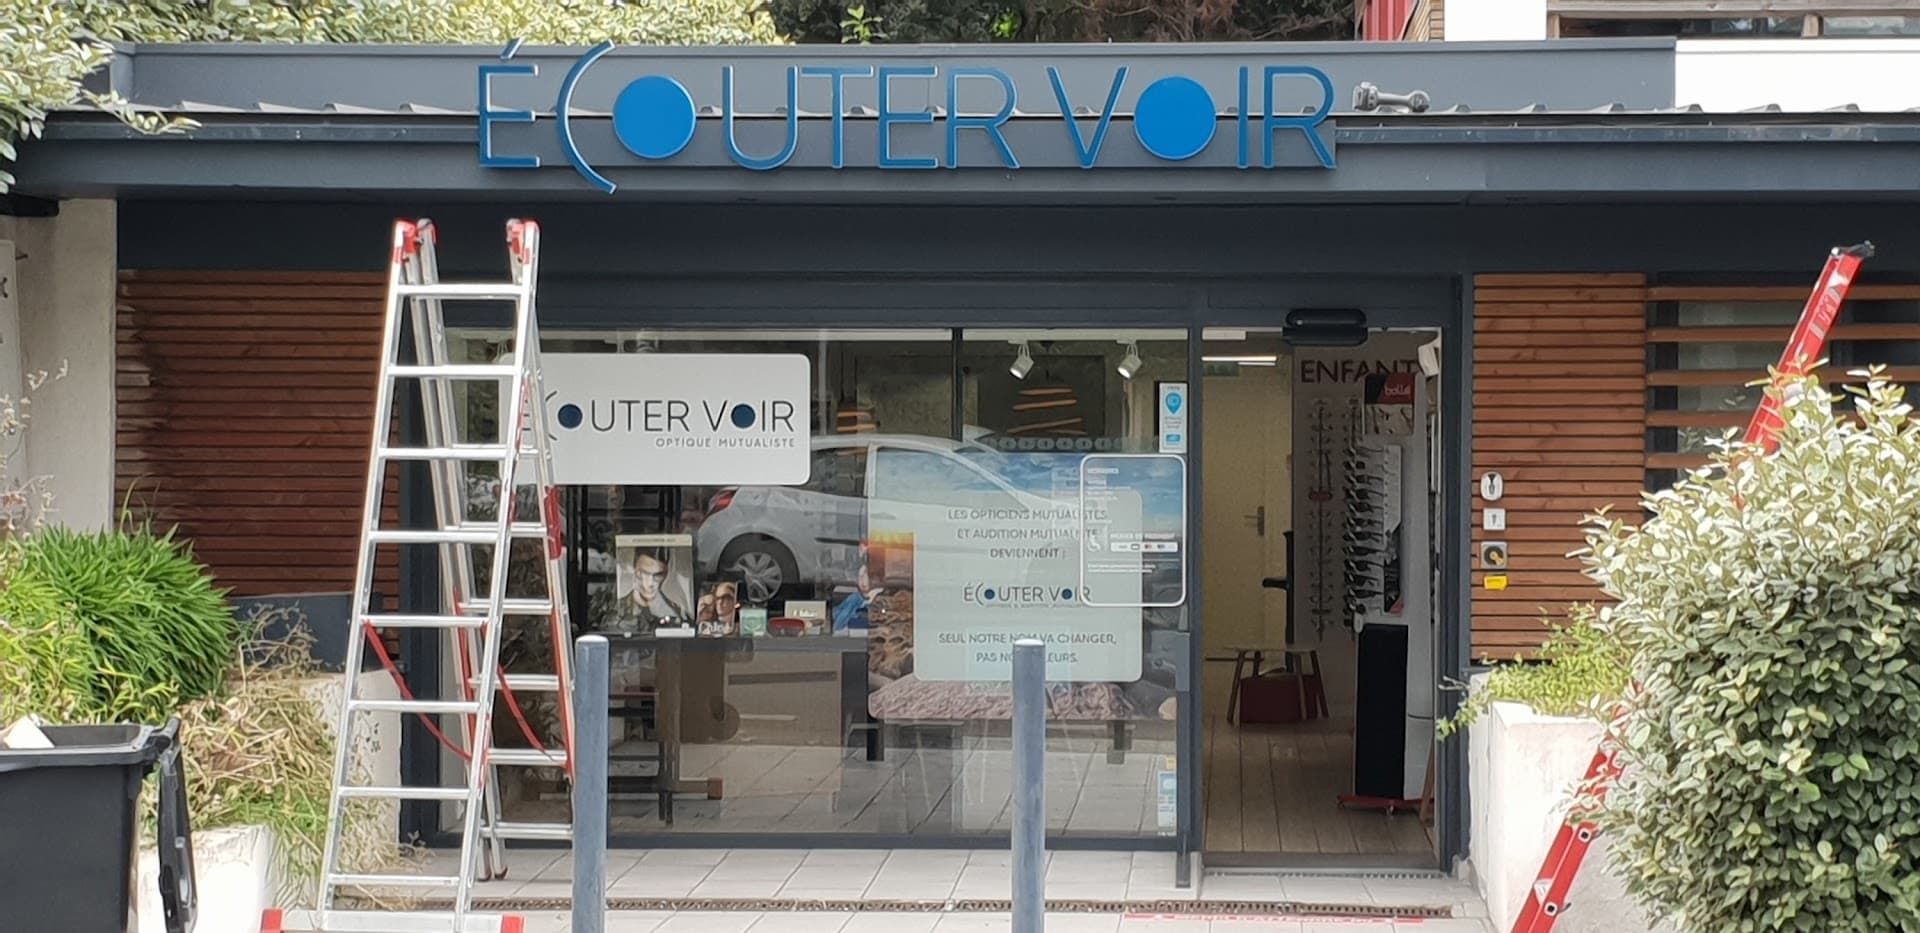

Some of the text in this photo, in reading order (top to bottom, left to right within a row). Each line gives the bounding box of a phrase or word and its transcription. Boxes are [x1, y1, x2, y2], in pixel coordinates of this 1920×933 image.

[477, 38, 1337, 194] ÉCOUTER VOIR
[702, 400, 795, 432] VOIR
[655, 437, 795, 448] OPTIQUE MUTUALISTE
[948, 509, 967, 520] LES
[970, 509, 1029, 520] OPTICIENS
[957, 528, 970, 539] ET
[973, 528, 1026, 539] AUDITION
[990, 547, 1059, 559] DEVIENNENT
[939, 633, 965, 644] SEUL
[969, 633, 1006, 644] NOTRE
[976, 652, 997, 663] PAS
